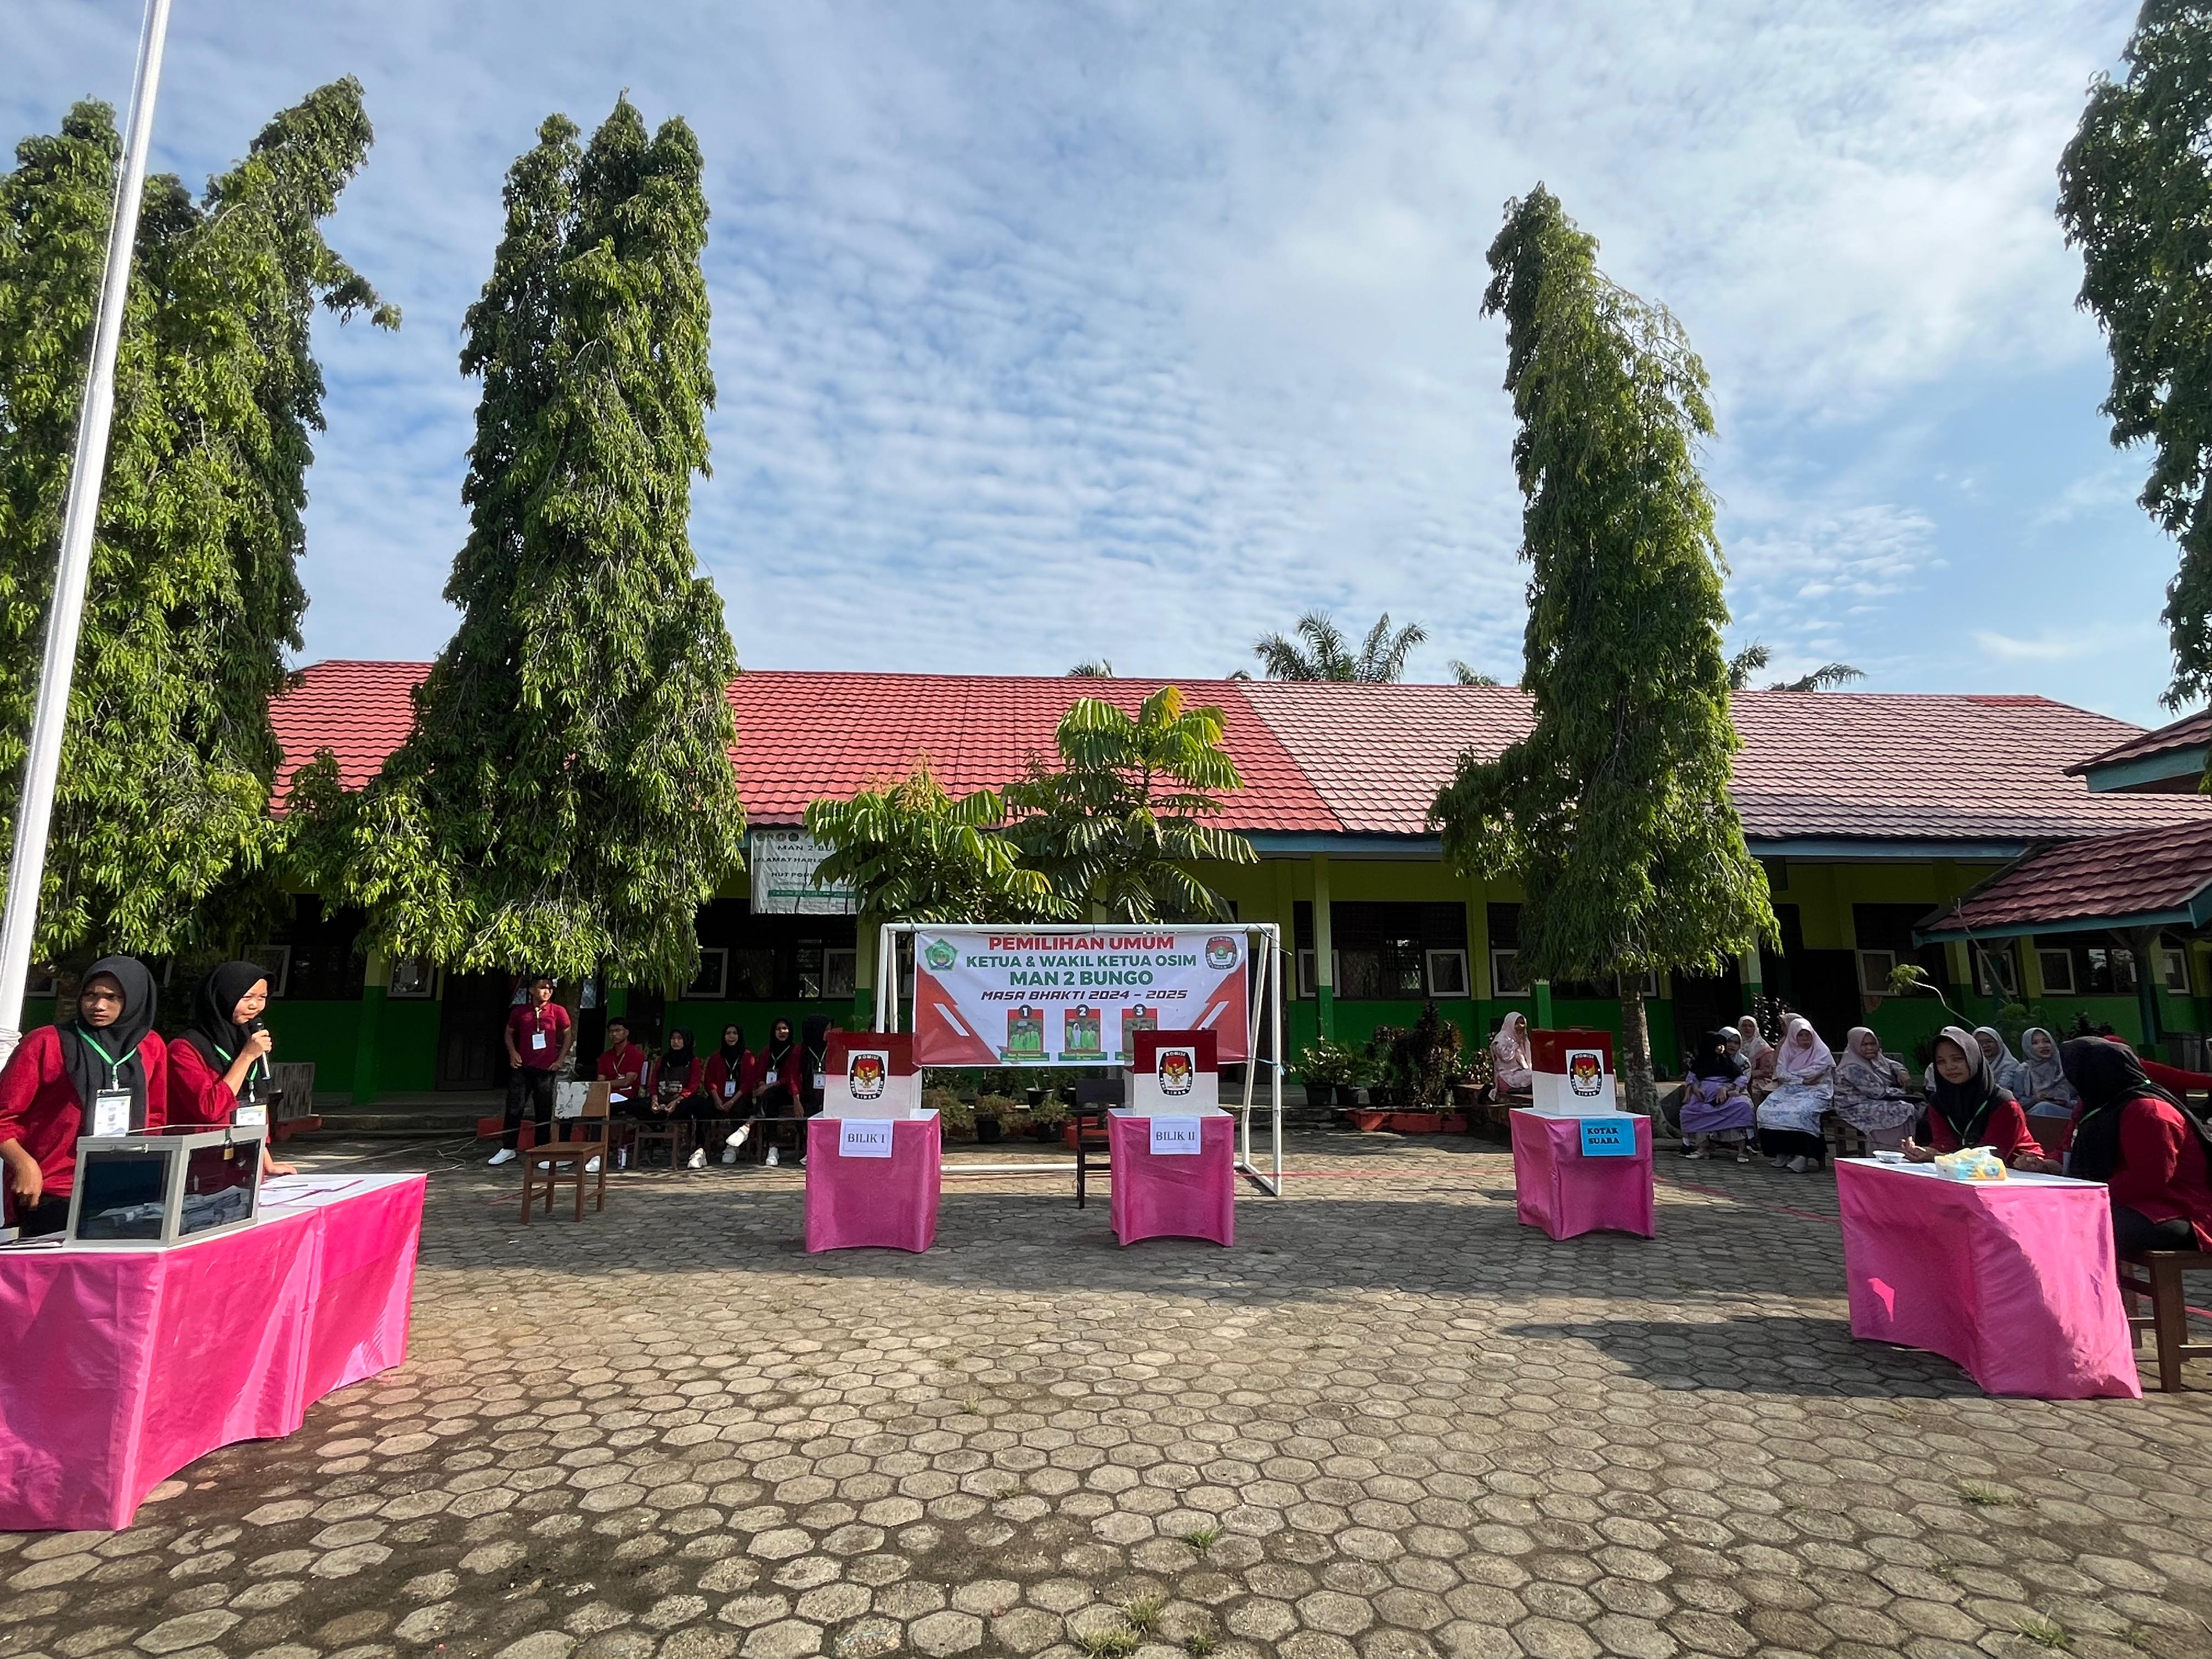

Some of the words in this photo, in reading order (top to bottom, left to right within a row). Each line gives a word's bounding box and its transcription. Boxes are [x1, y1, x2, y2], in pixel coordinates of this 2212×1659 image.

[989, 937, 1104, 950] PEMILIHAN
[1109, 936, 1174, 950] UMUM
[967, 956, 1022, 967] KETUA
[1026, 956, 1035, 967] &
[1039, 956, 1093, 967] WAKIL
[1097, 955, 1152, 967] KETUA
[1155, 955, 1197, 966] OSIM
[1010, 971, 1059, 986] MAN
[1063, 971, 1075, 986] 2
[1080, 970, 1153, 985] BUNGO
[981, 991, 1026, 1000] MASA
[1029, 991, 1085, 1000] BHAKTI
[1088, 990, 1130, 1000] 2024
[1146, 990, 1188, 999] 2025
[1023, 1007, 1028, 1016] 1
[1079, 1007, 1086, 1016] 2
[1136, 1007, 1143, 1015] 3
[848, 1133, 878, 1143] BILIK
[1156, 1131, 1186, 1141] BILIK
[1188, 1131, 1195, 1141] II
